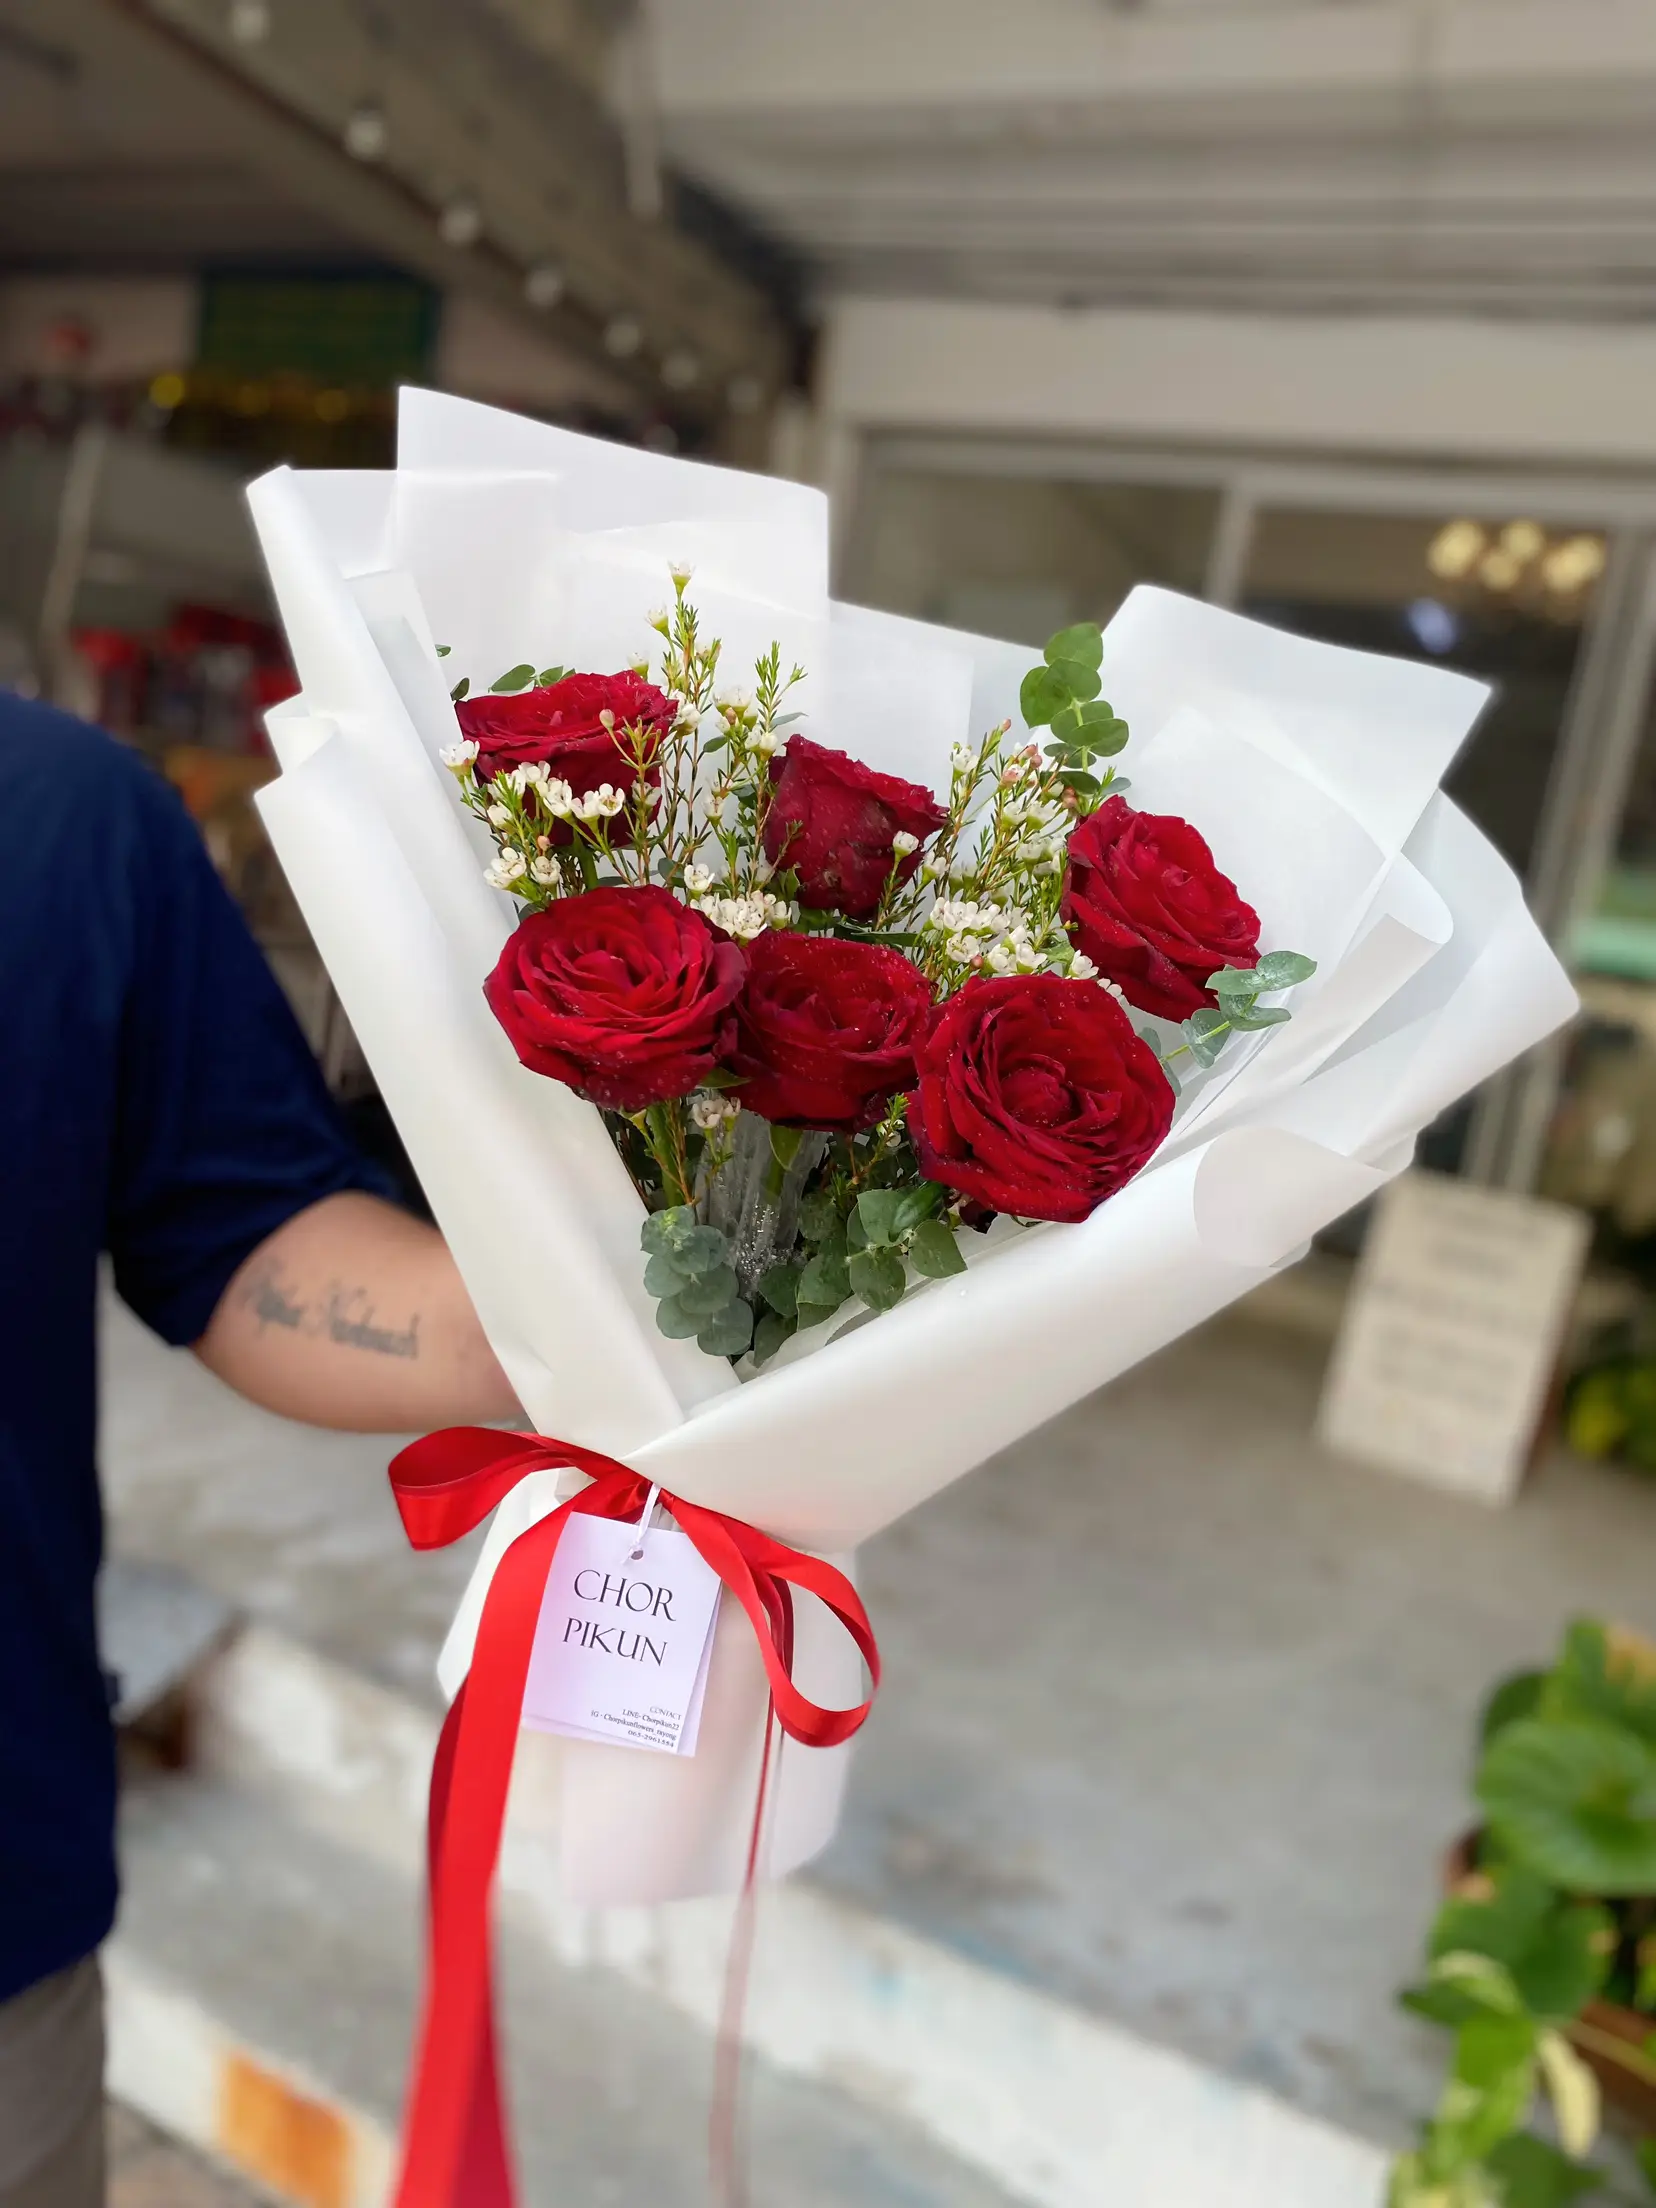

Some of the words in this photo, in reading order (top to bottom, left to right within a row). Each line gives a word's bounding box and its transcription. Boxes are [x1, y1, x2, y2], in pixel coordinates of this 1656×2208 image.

[574, 1569, 677, 1622] CHOR
[562, 1617, 668, 1667] PIKUN
[591, 1709, 599, 1718] IG
[649, 1706, 682, 1720] CONTACT
